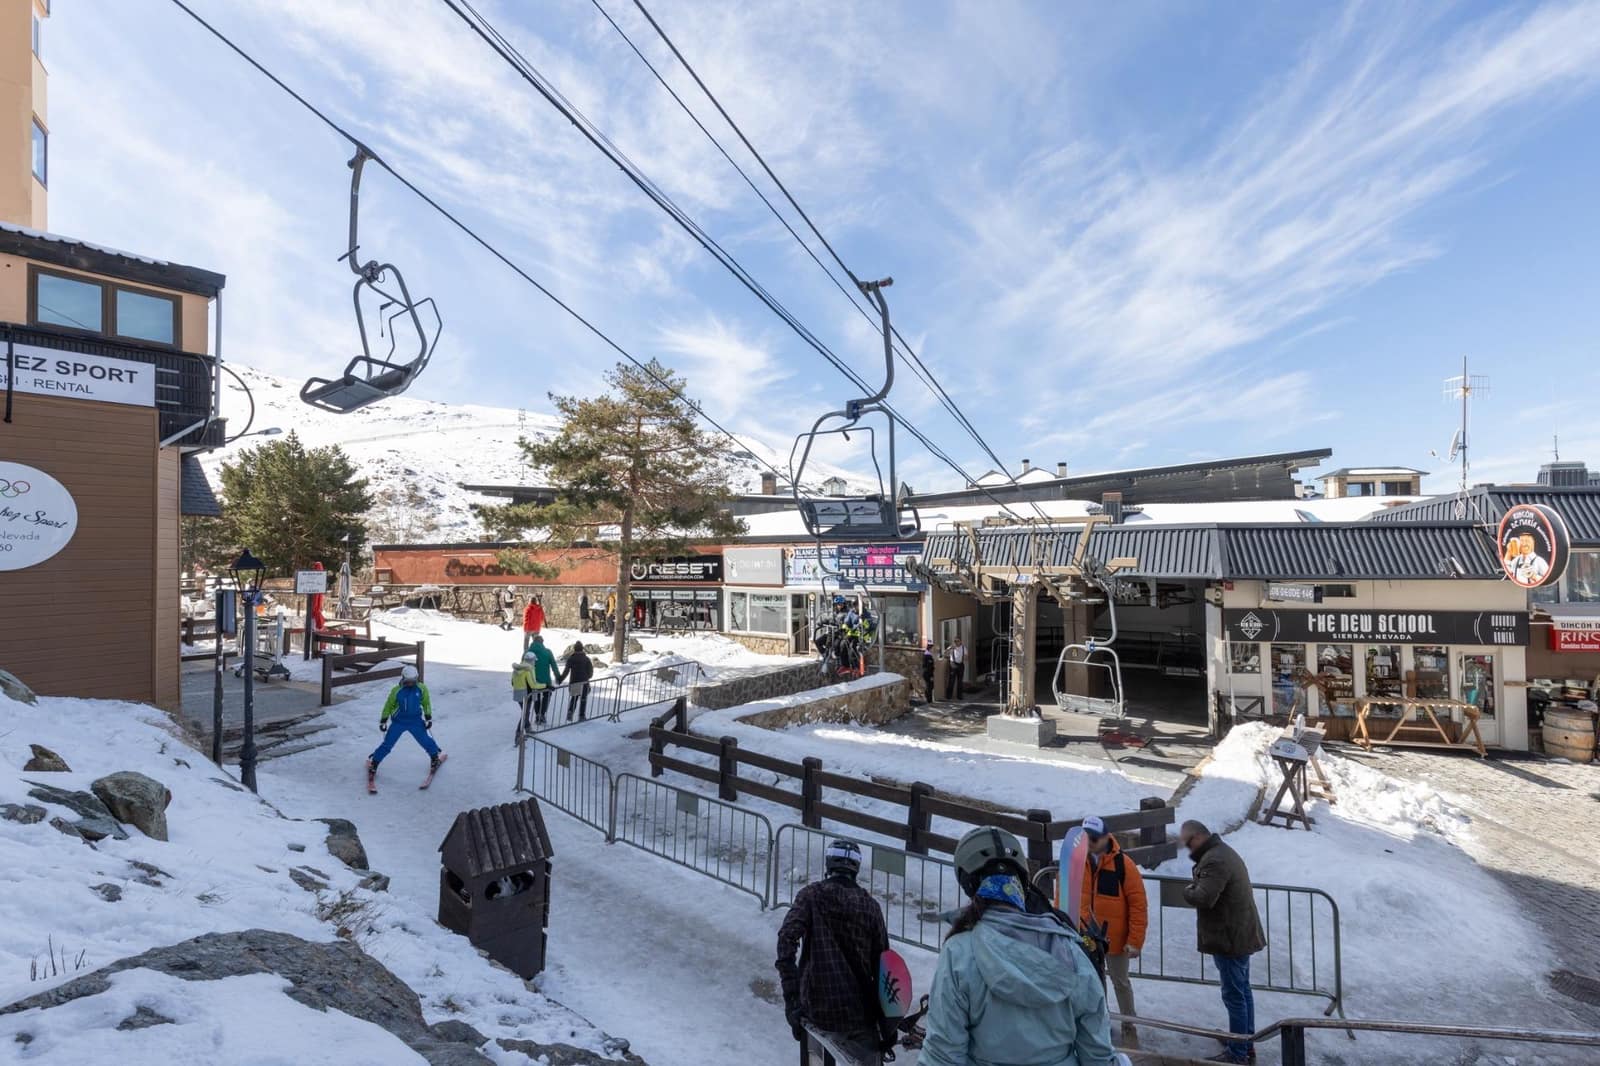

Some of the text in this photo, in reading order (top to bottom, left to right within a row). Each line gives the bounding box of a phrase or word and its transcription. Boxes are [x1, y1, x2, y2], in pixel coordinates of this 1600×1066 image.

[55, 360, 139, 384] SPORT
[33, 378, 94, 394] RENTAL
[649, 562, 718, 574] RESET
[1308, 613, 1436, 634] THE NEW SCHOOL
[1332, 632, 1412, 641] SIERRA NEVADA
